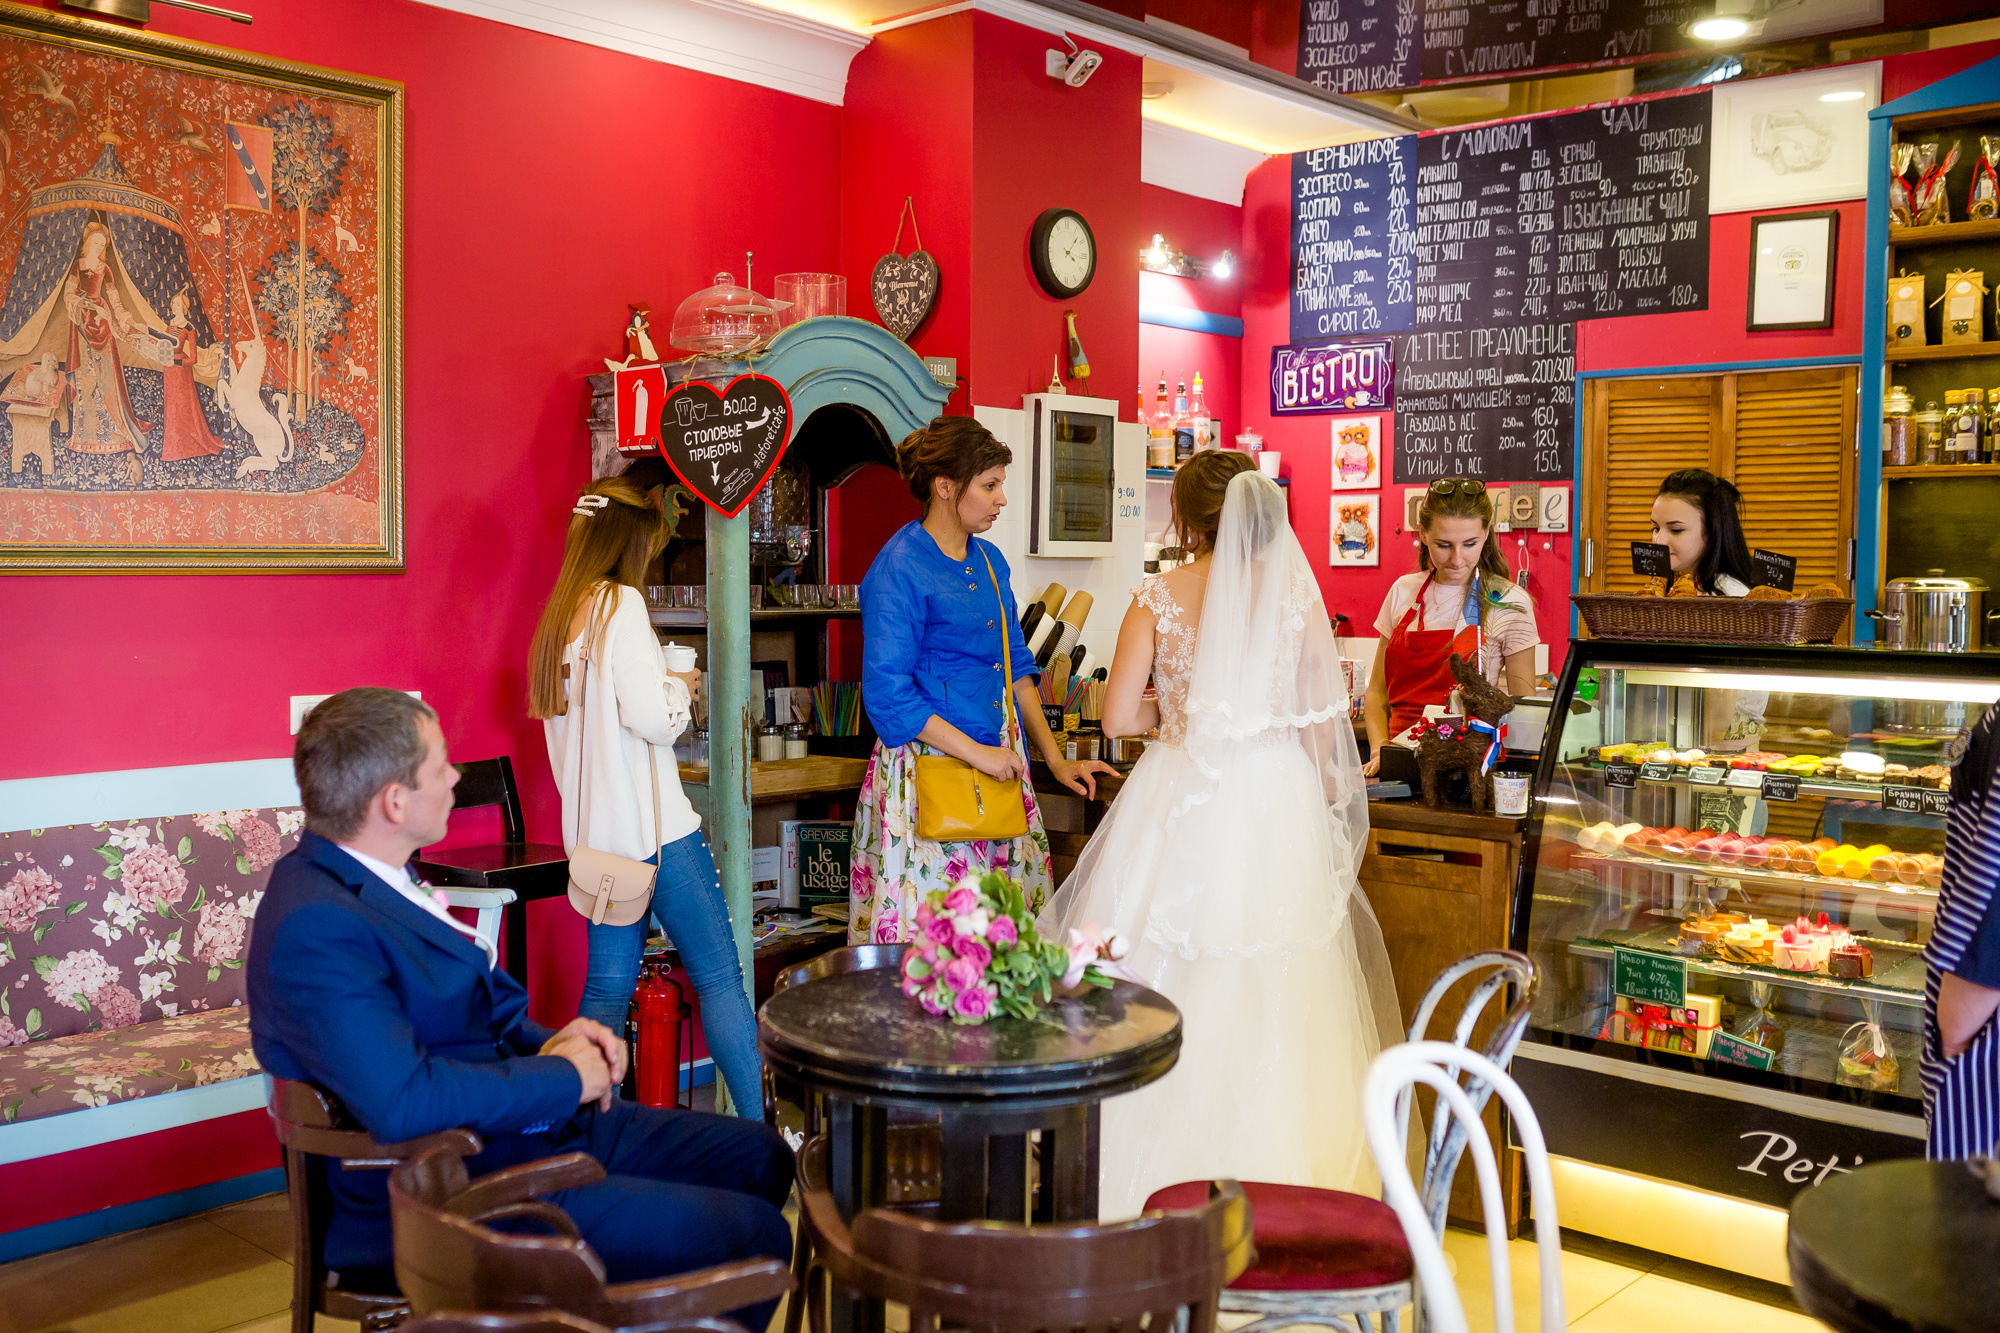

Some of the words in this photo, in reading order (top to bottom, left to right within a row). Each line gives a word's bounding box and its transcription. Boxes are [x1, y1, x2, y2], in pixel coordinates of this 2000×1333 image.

[1602, 102, 1649, 135] ЧАЙ
[1441, 134, 1451, 161] С
[1455, 122, 1532, 159] МОЛОКОМ
[1640, 123, 1703, 152] ФРУКТОВЫЙ
[1306, 141, 1366, 172] ЧЕРНЫЙ
[1367, 136, 1404, 164] КОФЕ
[1560, 140, 1595, 164] ЧЕРНЫЙ
[1636, 147, 1686, 175] ТРАВЯНОЙ
[1417, 162, 1458, 184] МАКИАТО
[1557, 159, 1602, 186] ЗЕЛЕНЫЙ
[1417, 181, 1462, 204] КАПУЧИНО
[1298, 196, 1341, 220] ДОППИО
[1417, 202, 1459, 224] КАПУЧИНО
[1461, 200, 1477, 219] СОЯ
[1298, 219, 1330, 244] ЛУНГО
[1473, 219, 1490, 239] СОЯ
[1611, 222, 1667, 247] МОЛОЧНЫЙ
[1671, 220, 1698, 242] УЛУН
[1297, 238, 1353, 267] АМЕРИКАНО
[1416, 244, 1439, 263] ФЛЕТ
[1557, 254, 1573, 274] ЭРЛ
[1576, 250, 1596, 272] ГРЕЙ
[1619, 245, 1662, 268] РОЙБУШ
[1297, 264, 1334, 290] БАМБЛ
[1417, 265, 1437, 283] РАФ
[1557, 270, 1608, 295] ИВАН-ЧАЙ
[1617, 266, 1667, 290] МАСАЛА
[1296, 286, 1327, 313] ТОНИК
[1328, 284, 1355, 309] КОФЕ
[1417, 285, 1437, 304] РАФ
[1439, 282, 1471, 303] ЦИТРУС
[1318, 310, 1357, 334] СИРОП
[1416, 305, 1437, 324] РАФ
[1439, 303, 1462, 323] МЕД
[1402, 330, 1463, 362] ЛЕТНЕЕ
[1283, 349, 1375, 406] BISTRO
[723, 395, 757, 417] ВОДА
[683, 422, 743, 446] СТОЛОВЫЕ
[752, 404, 787, 470] #laforetcafe
[688, 440, 743, 462] ПРИБОРЫ
[1118, 487, 1135, 499] 9:00
[1888, 789, 1920, 800] БРАУНИ
[800, 830, 849, 841] GREVISSE
[818, 843, 832, 862] le
[808, 856, 841, 875] bon
[802, 874, 849, 893] usage
